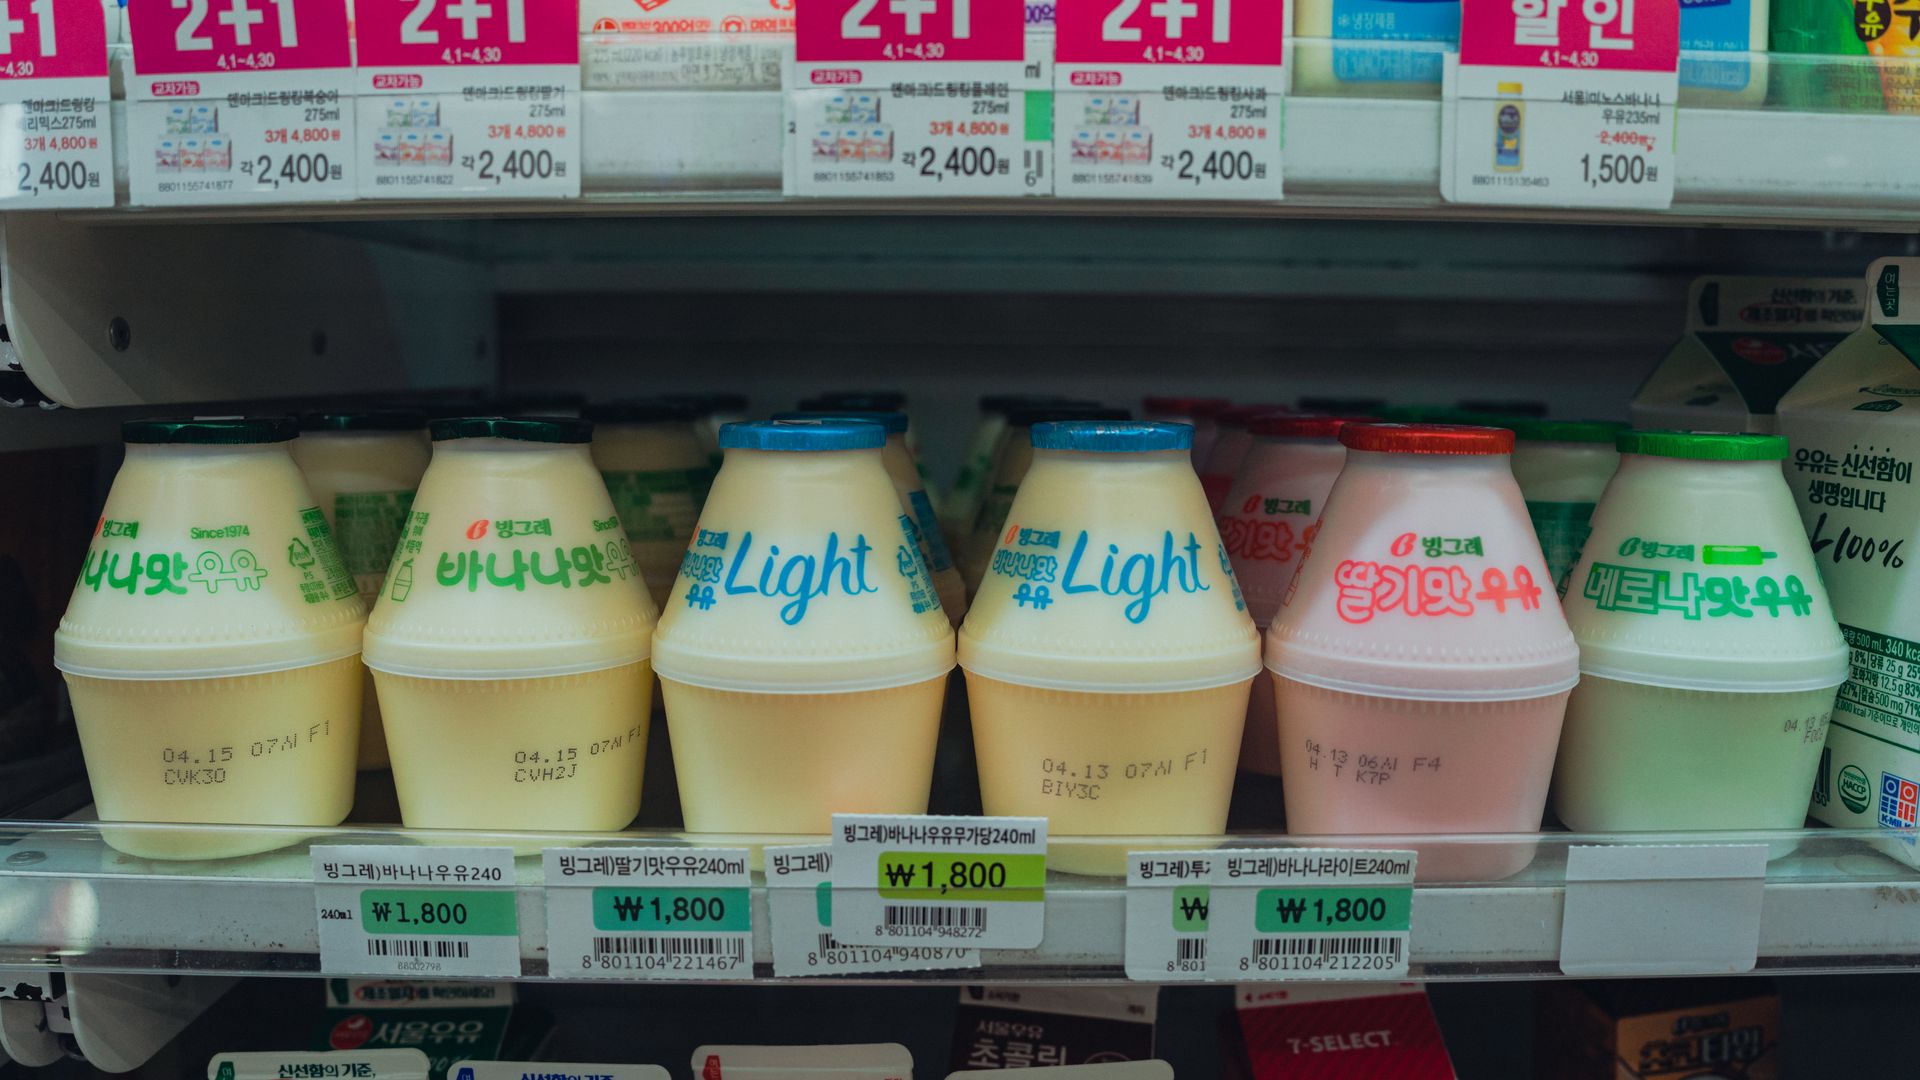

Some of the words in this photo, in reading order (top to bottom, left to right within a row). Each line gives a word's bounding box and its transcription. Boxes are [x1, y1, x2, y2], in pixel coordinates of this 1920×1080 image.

[171, 0, 299, 51] 2+1
[401, 0, 527, 44] 2+1
[841, 0, 971, 39] 2+1
[1102, 0, 1231, 43] 2+1
[154, 81, 198, 95] 교차가능
[304, 108, 341, 122] 275ml
[529, 104, 566, 118] 275ml
[972, 101, 1009, 115] 275ml
[1231, 105, 1267, 118] 275ml
[1602, 108, 1661, 125] 우유235ml
[264, 129, 288, 143] 3개
[488, 124, 511, 139] 3개
[929, 122, 953, 136] 3개
[1188, 125, 1212, 140] 3개
[24, 136, 46, 151] 3개
[241, 160, 254, 175] 각
[461, 155, 476, 171] 각
[902, 152, 916, 168] 각
[1161, 154, 1174, 170] 각
[1794, 447, 1839, 475] 우유는
[1841, 452, 1913, 484] 신선함이
[1808, 479, 1886, 513] 생명입니다
[102, 519, 140, 540] 빙그레
[190, 524, 250, 540] Since1974
[495, 518, 553, 539] 빙그레
[1018, 527, 1061, 549] 빙그레
[1421, 536, 1484, 557] 빙그레
[1642, 540, 1695, 562] 빙그레
[992, 547, 1059, 583] 바나나맛
[724, 530, 879, 626] Light
[1062, 529, 1210, 625] Light
[685, 583, 717, 611] 우유
[1012, 582, 1054, 610] 우유
[1856, 632, 1871, 648] 500
[1871, 638, 1884, 653] mL
[1885, 638, 1904, 658] 340
[1855, 649, 1866, 665] 8%
[1870, 654, 1884, 671] 당류
[1886, 659, 1896, 673] 25
[1897, 665, 1904, 678] g
[1881, 675, 1897, 692] 12.5
[1898, 684, 1904, 697] g
[1853, 705, 1867, 718] kcal
[1861, 687, 1875, 704] 칼슘
[1874, 693, 1890, 708] 500
[1890, 700, 1903, 715] mg
[163, 746, 233, 763] 04.15
[309, 719, 329, 742] F1
[514, 747, 578, 763] 04.15
[628, 725, 641, 743] F1
[1042, 758, 1110, 779] 04.13
[1185, 748, 1207, 770] F1
[1305, 738, 1348, 765] 04.13
[1412, 756, 1441, 772] F4
[514, 763, 578, 782] CVH2J
[1355, 770, 1391, 785] K7P
[1842, 778, 1867, 795] HACCP
[842, 823, 1037, 847] 빙그레)바나나우유무가당240ml
[323, 861, 502, 882] 빙그레)바나나우유240
[559, 855, 745, 876] 빙그레)딸기맛우유240ml
[1227, 857, 1410, 877] 빙그레)바나나라이트240ml
[320, 908, 353, 920] 240ml
[887, 926, 933, 938] 801104
[937, 926, 983, 939] 948272
[397, 961, 442, 971] 88002798
[582, 955, 592, 970] 8
[601, 955, 666, 970] 801104
[672, 955, 738, 970] 221467
[808, 951, 818, 966] 8
[826, 947, 893, 966] 801104
[1166, 960, 1175, 972] 8
[1239, 957, 1249, 971] 8
[1258, 956, 1324, 971] 801104
[1331, 955, 1394, 970] 212205
[373, 1020, 485, 1045] 서울우유
[976, 1019, 1044, 1040] 서울우유
[1287, 1030, 1392, 1054] 7-SELECT
[277, 1063, 338, 1079] 신선함의
